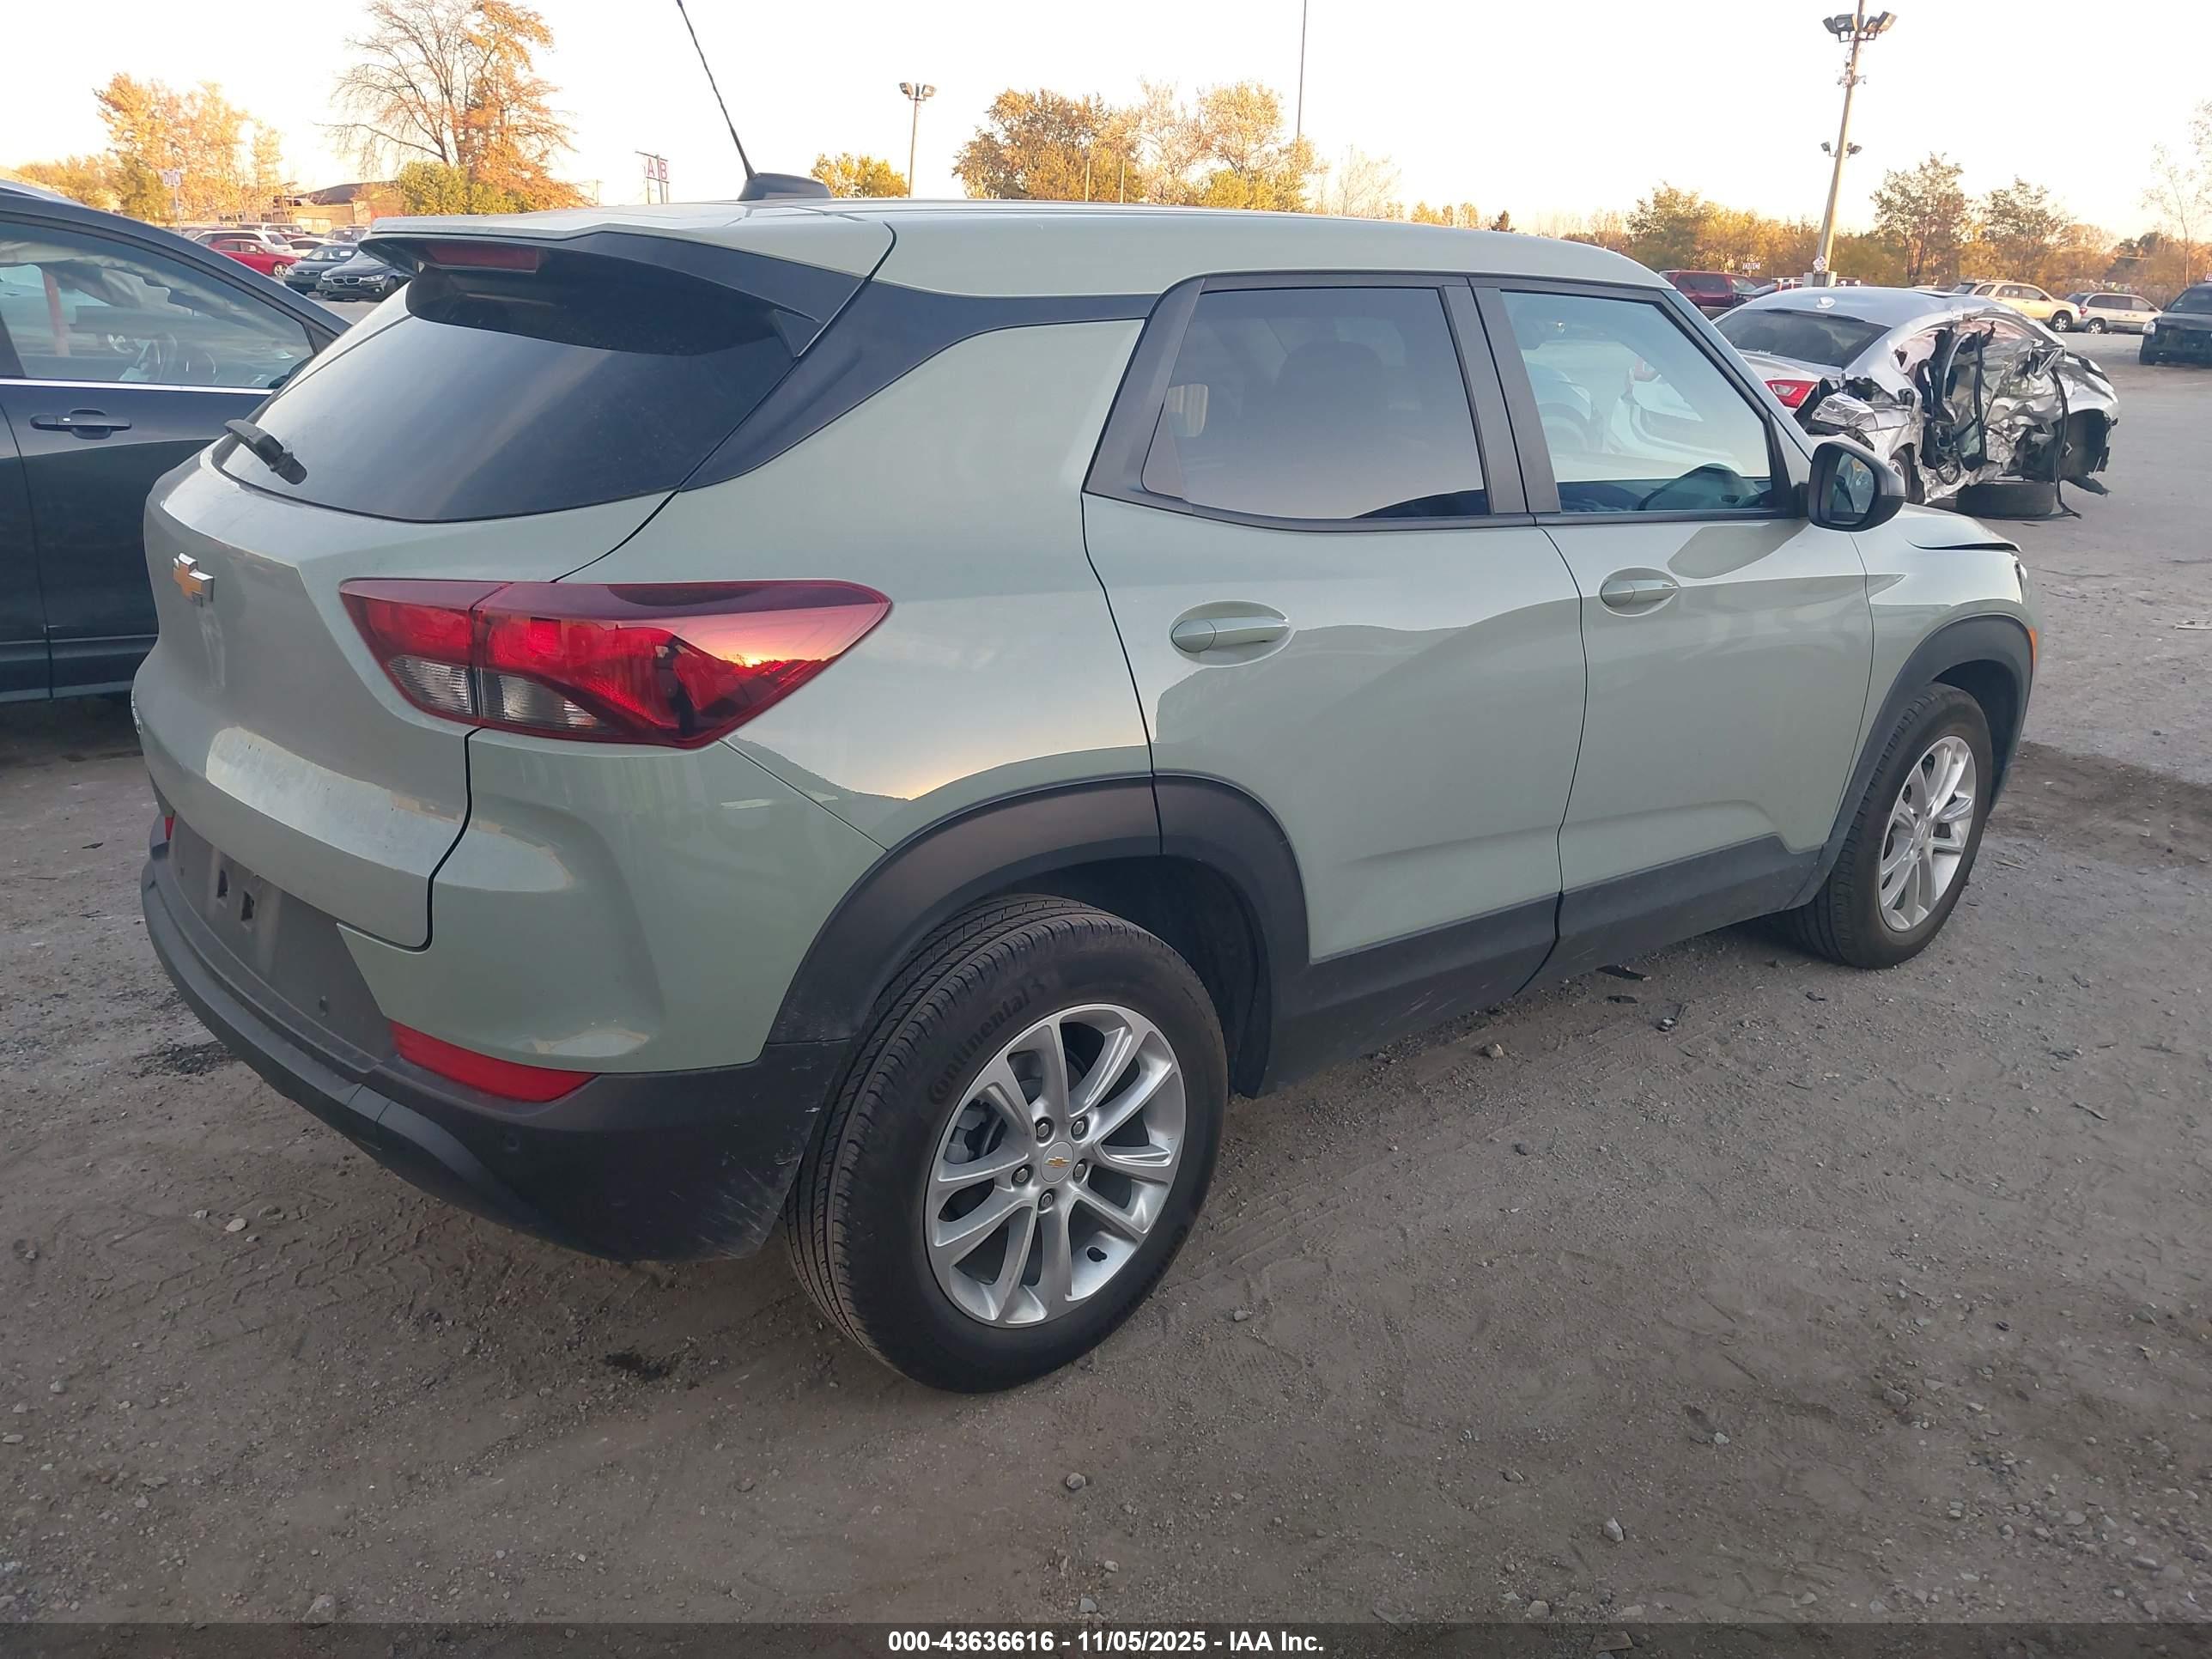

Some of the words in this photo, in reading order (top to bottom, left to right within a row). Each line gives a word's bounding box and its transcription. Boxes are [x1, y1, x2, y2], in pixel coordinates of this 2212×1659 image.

[647, 157, 655, 177] A
[659, 161, 667, 180] B
[927, 986, 1031, 1105] Continental
